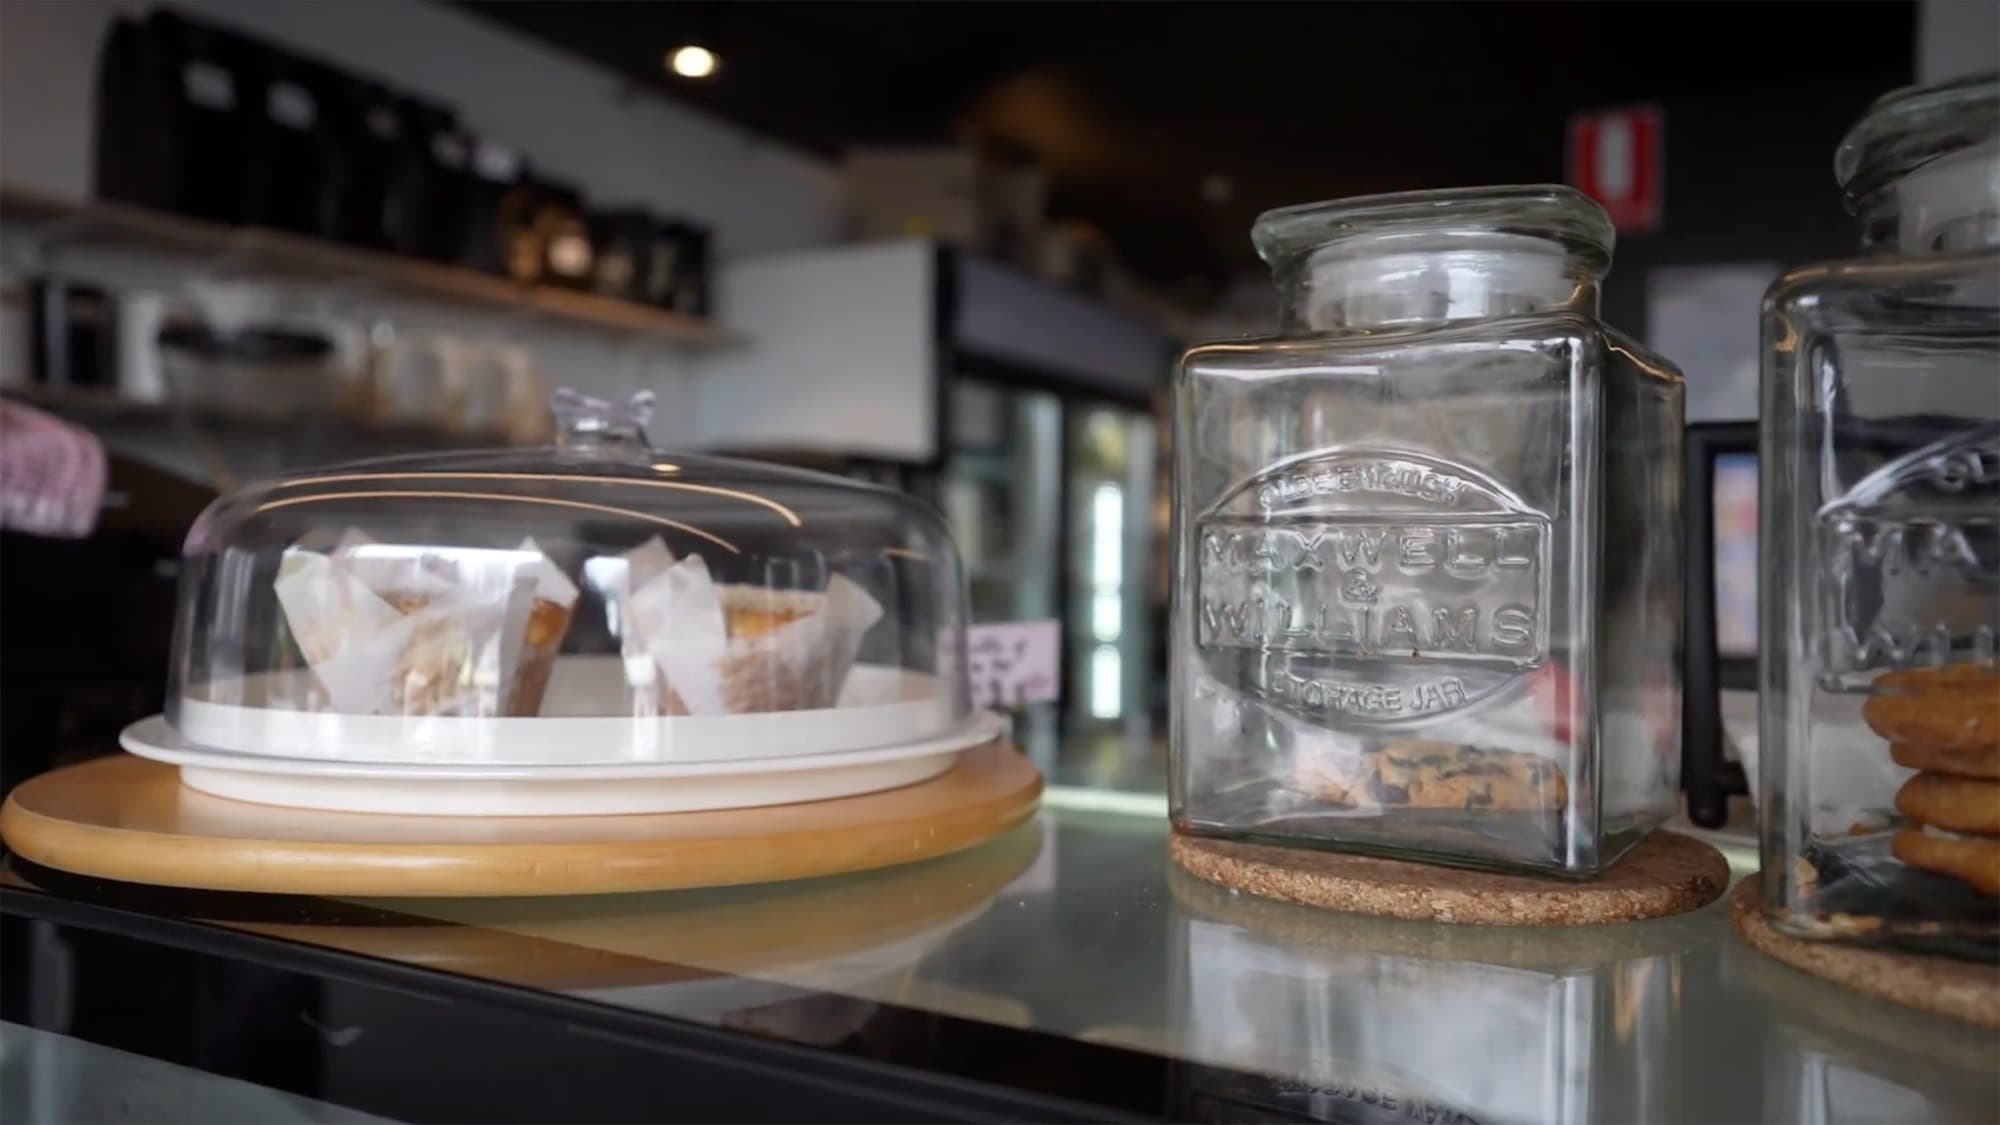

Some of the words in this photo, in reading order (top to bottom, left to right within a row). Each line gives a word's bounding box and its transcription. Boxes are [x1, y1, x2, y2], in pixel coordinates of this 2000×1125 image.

[1204, 528, 1534, 570] MAXWELL
[1342, 567, 1379, 604] &
[1204, 598, 1533, 648] WILLIAMS
[1272, 671, 1402, 712] STORAGE
[1409, 676, 1469, 710] JAR
